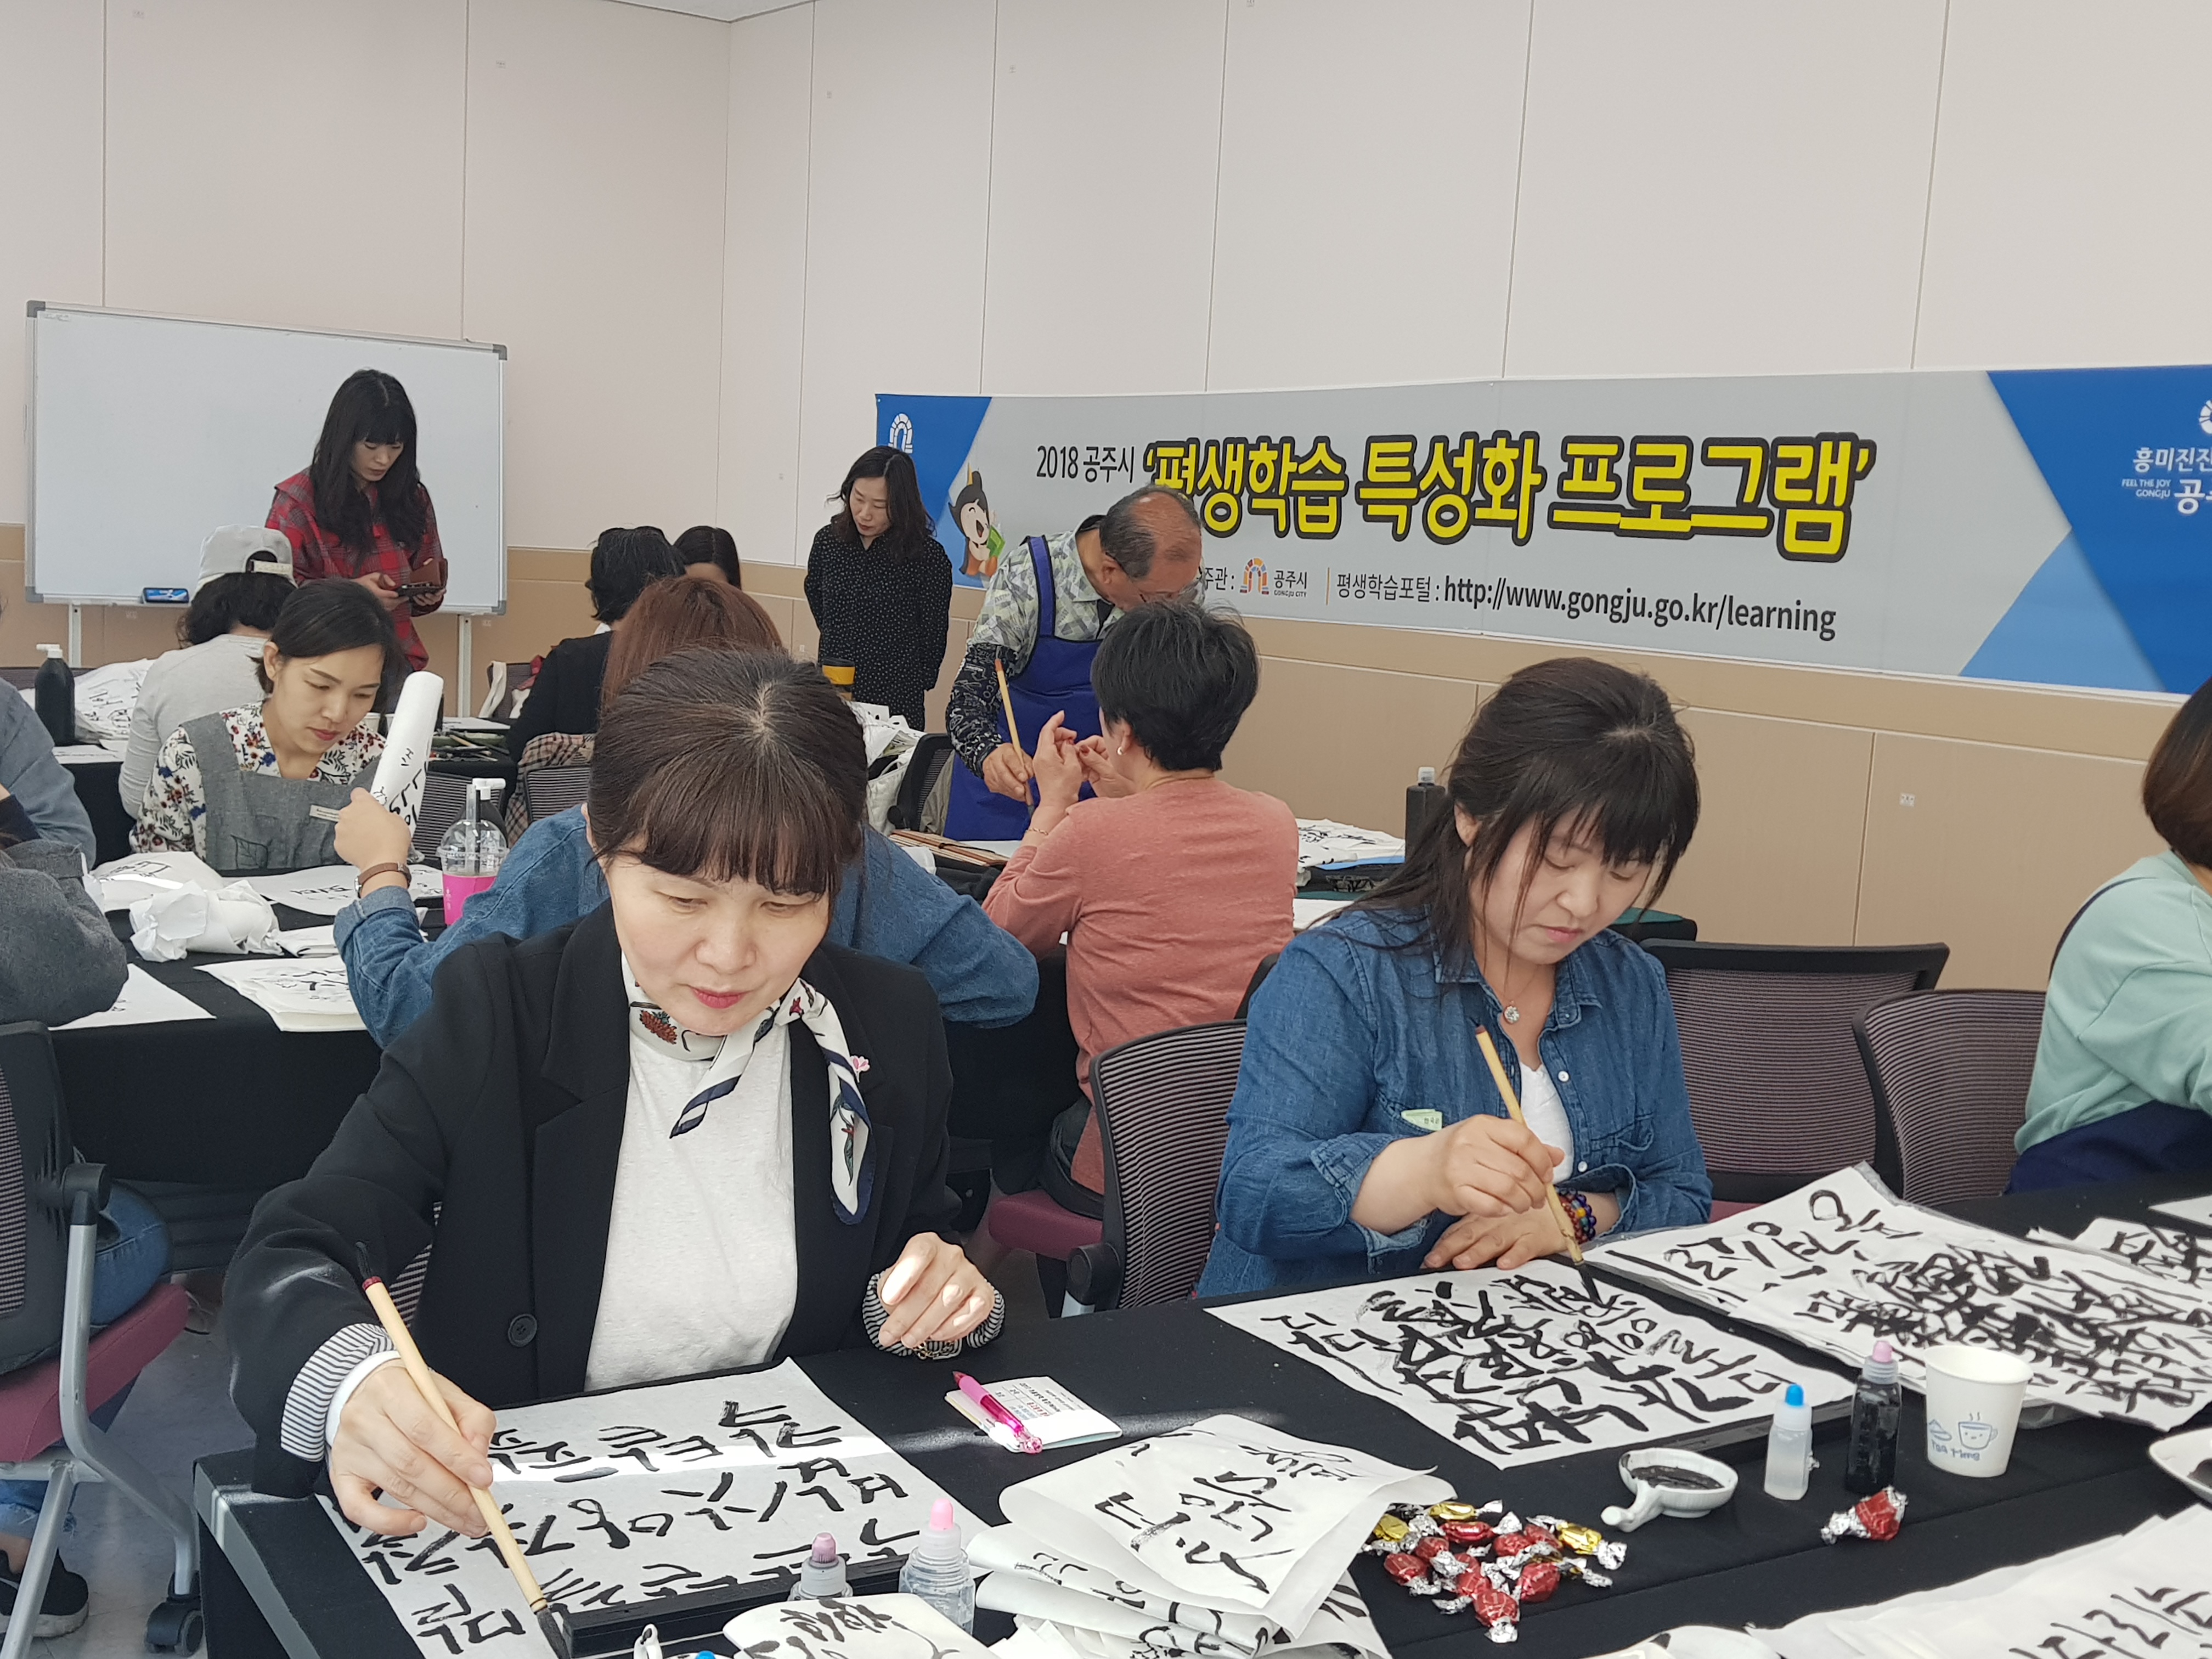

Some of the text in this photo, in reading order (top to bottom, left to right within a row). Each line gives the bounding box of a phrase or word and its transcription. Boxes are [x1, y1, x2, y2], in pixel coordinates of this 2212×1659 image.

[1036, 445, 1079, 479] 2018
[1082, 445, 1135, 484] 공주시
[1354, 430, 1547, 547] 특성화
[2121, 478, 2171, 488] FEEL THE JOY
[2135, 489, 2171, 499] GONGJU
[1273, 570, 1308, 590] 공주시
[1336, 573, 1431, 603] 평생학습포털
[1444, 575, 1837, 642] http://www.gongju.go.kr/learning
